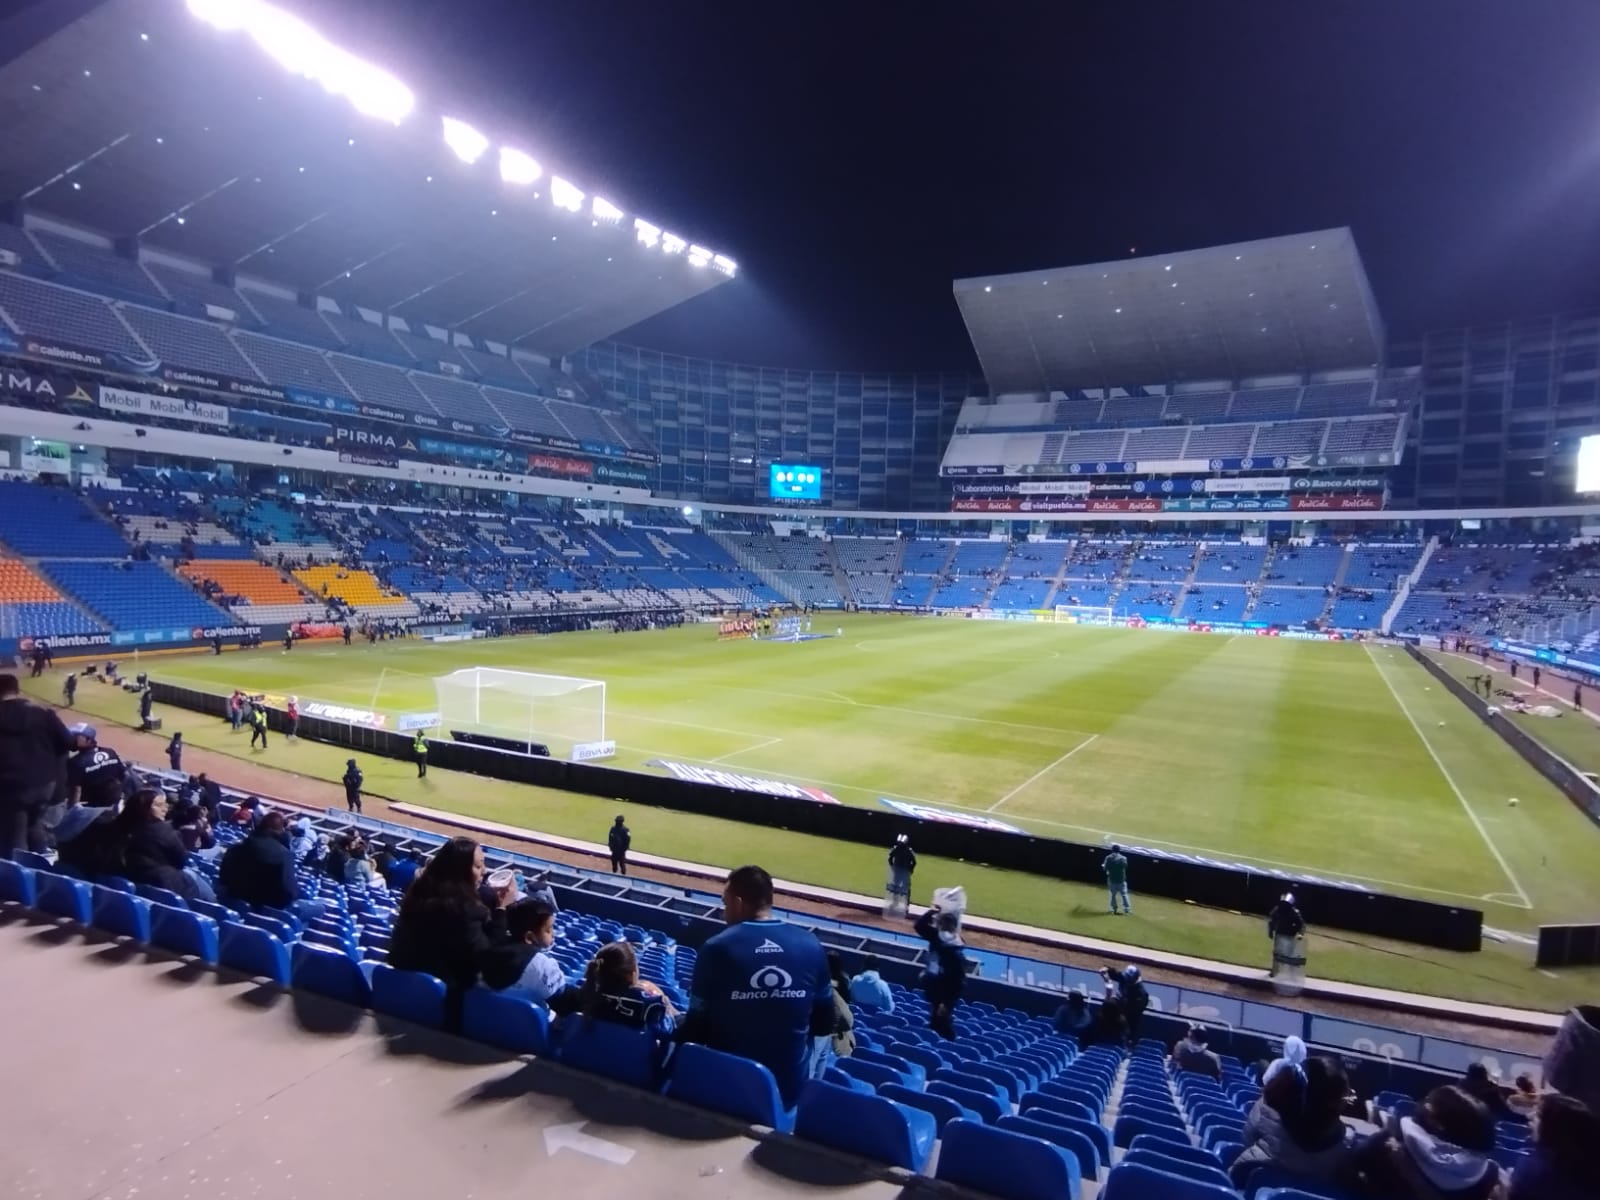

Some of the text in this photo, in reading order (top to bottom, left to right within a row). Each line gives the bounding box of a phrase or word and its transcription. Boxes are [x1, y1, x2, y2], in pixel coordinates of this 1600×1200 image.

[40, 346, 102, 364] caliente.mx
[0, 373, 56, 396] MA
[173, 372, 218, 386] caliente.mx
[239, 385, 284, 399] caliente.mx
[103, 392, 224, 420] Mobil Mobil Mobil
[336, 428, 396, 448] PIRMA
[962, 483, 1003, 493] Laboratorios
[1312, 479, 1379, 488] Banco Azteca
[418, 615, 450, 623] PIRMA
[203, 626, 261, 638] caliente.mx
[731, 988, 807, 1000] Banco Azteca
